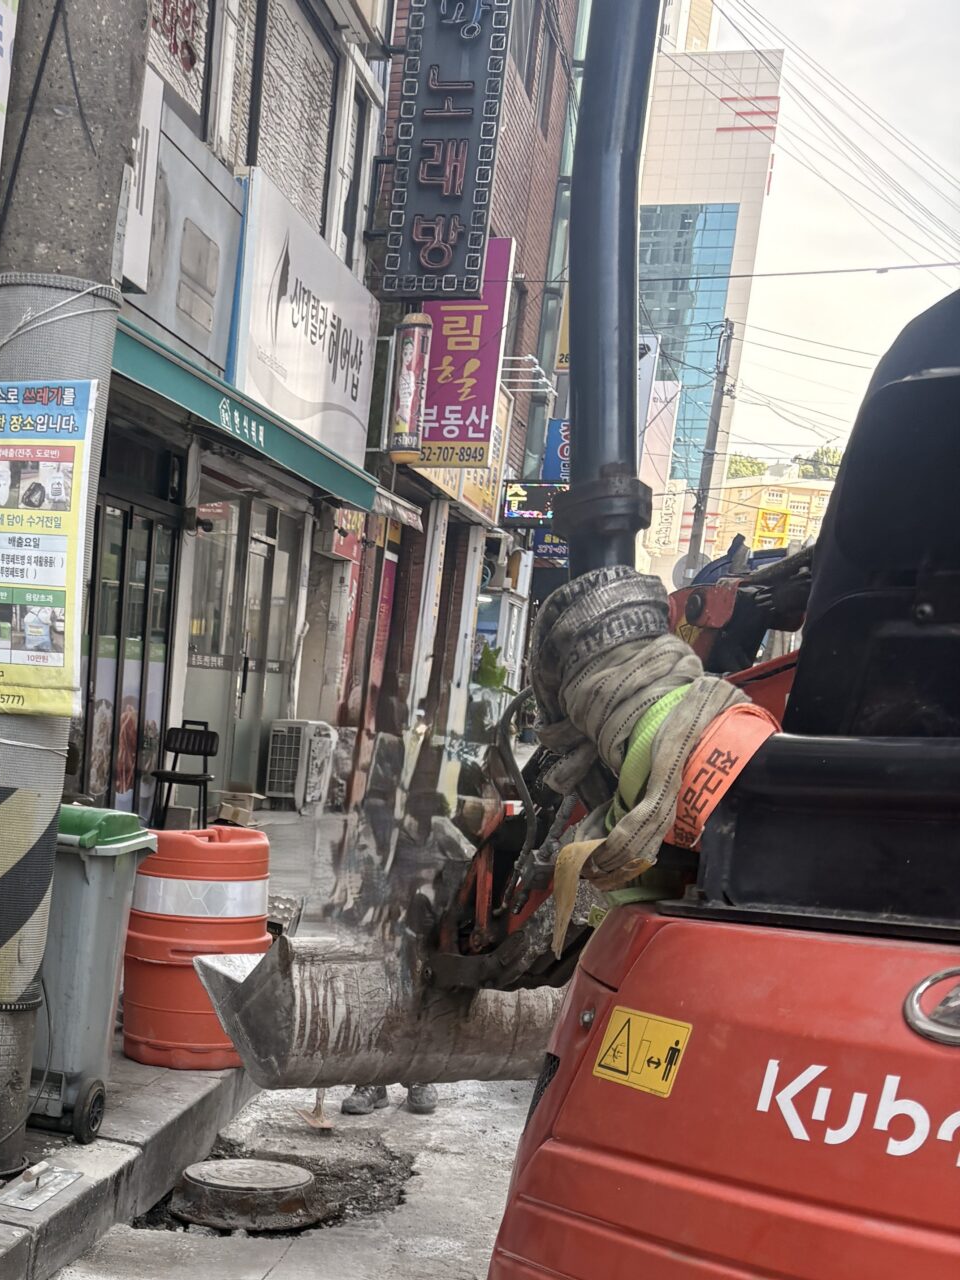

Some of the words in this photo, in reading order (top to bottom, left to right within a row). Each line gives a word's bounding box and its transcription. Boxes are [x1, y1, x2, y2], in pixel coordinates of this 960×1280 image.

[411, 65, 476, 268] 노래방
[290, 277, 329, 352] 신데렐라
[327, 312, 364, 402] 헤어샵
[22, 386, 76, 407] 쓰레기를
[9, 414, 79, 433] 장소입니다.
[423, 404, 489, 439] 부동산
[420, 446, 485, 462] 52-707-8949
[6, 514, 25, 527] 담아
[26, 516, 62, 529] 수거전일
[7, 536, 41, 549] 배출요일
[676, 747, 740, 831] 접근금지
